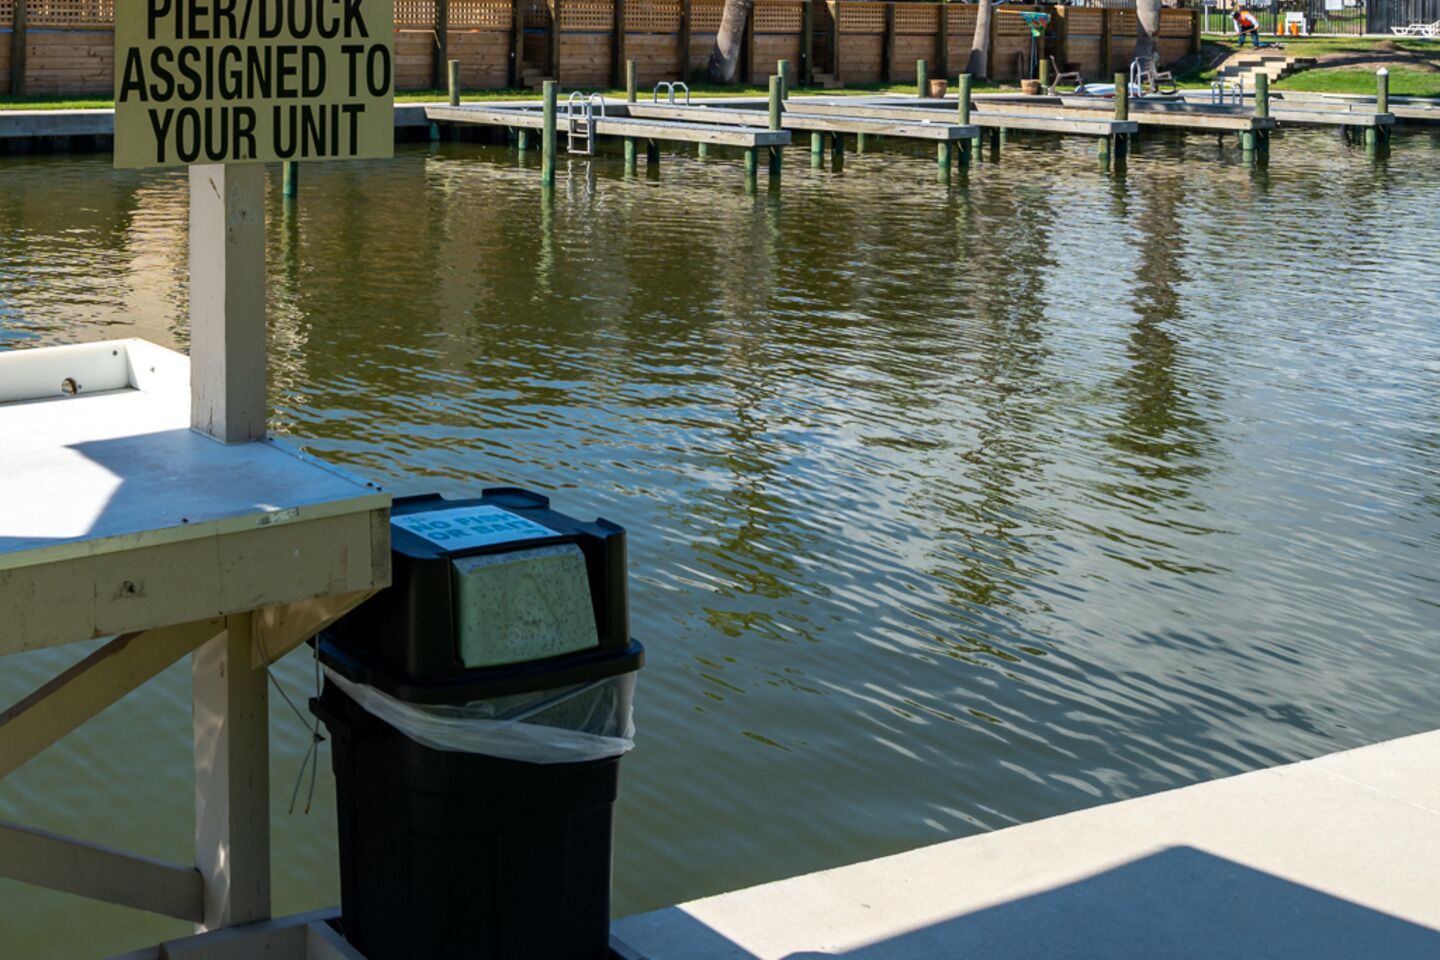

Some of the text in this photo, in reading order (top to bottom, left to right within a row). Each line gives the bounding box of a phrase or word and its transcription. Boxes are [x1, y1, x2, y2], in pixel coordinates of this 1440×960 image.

[119, 44, 391, 102] ASSIGNED TO
[148, 104, 365, 163] YOUR UNIT
[408, 520, 452, 533] NO
[427, 520, 534, 540] OR BAIT
